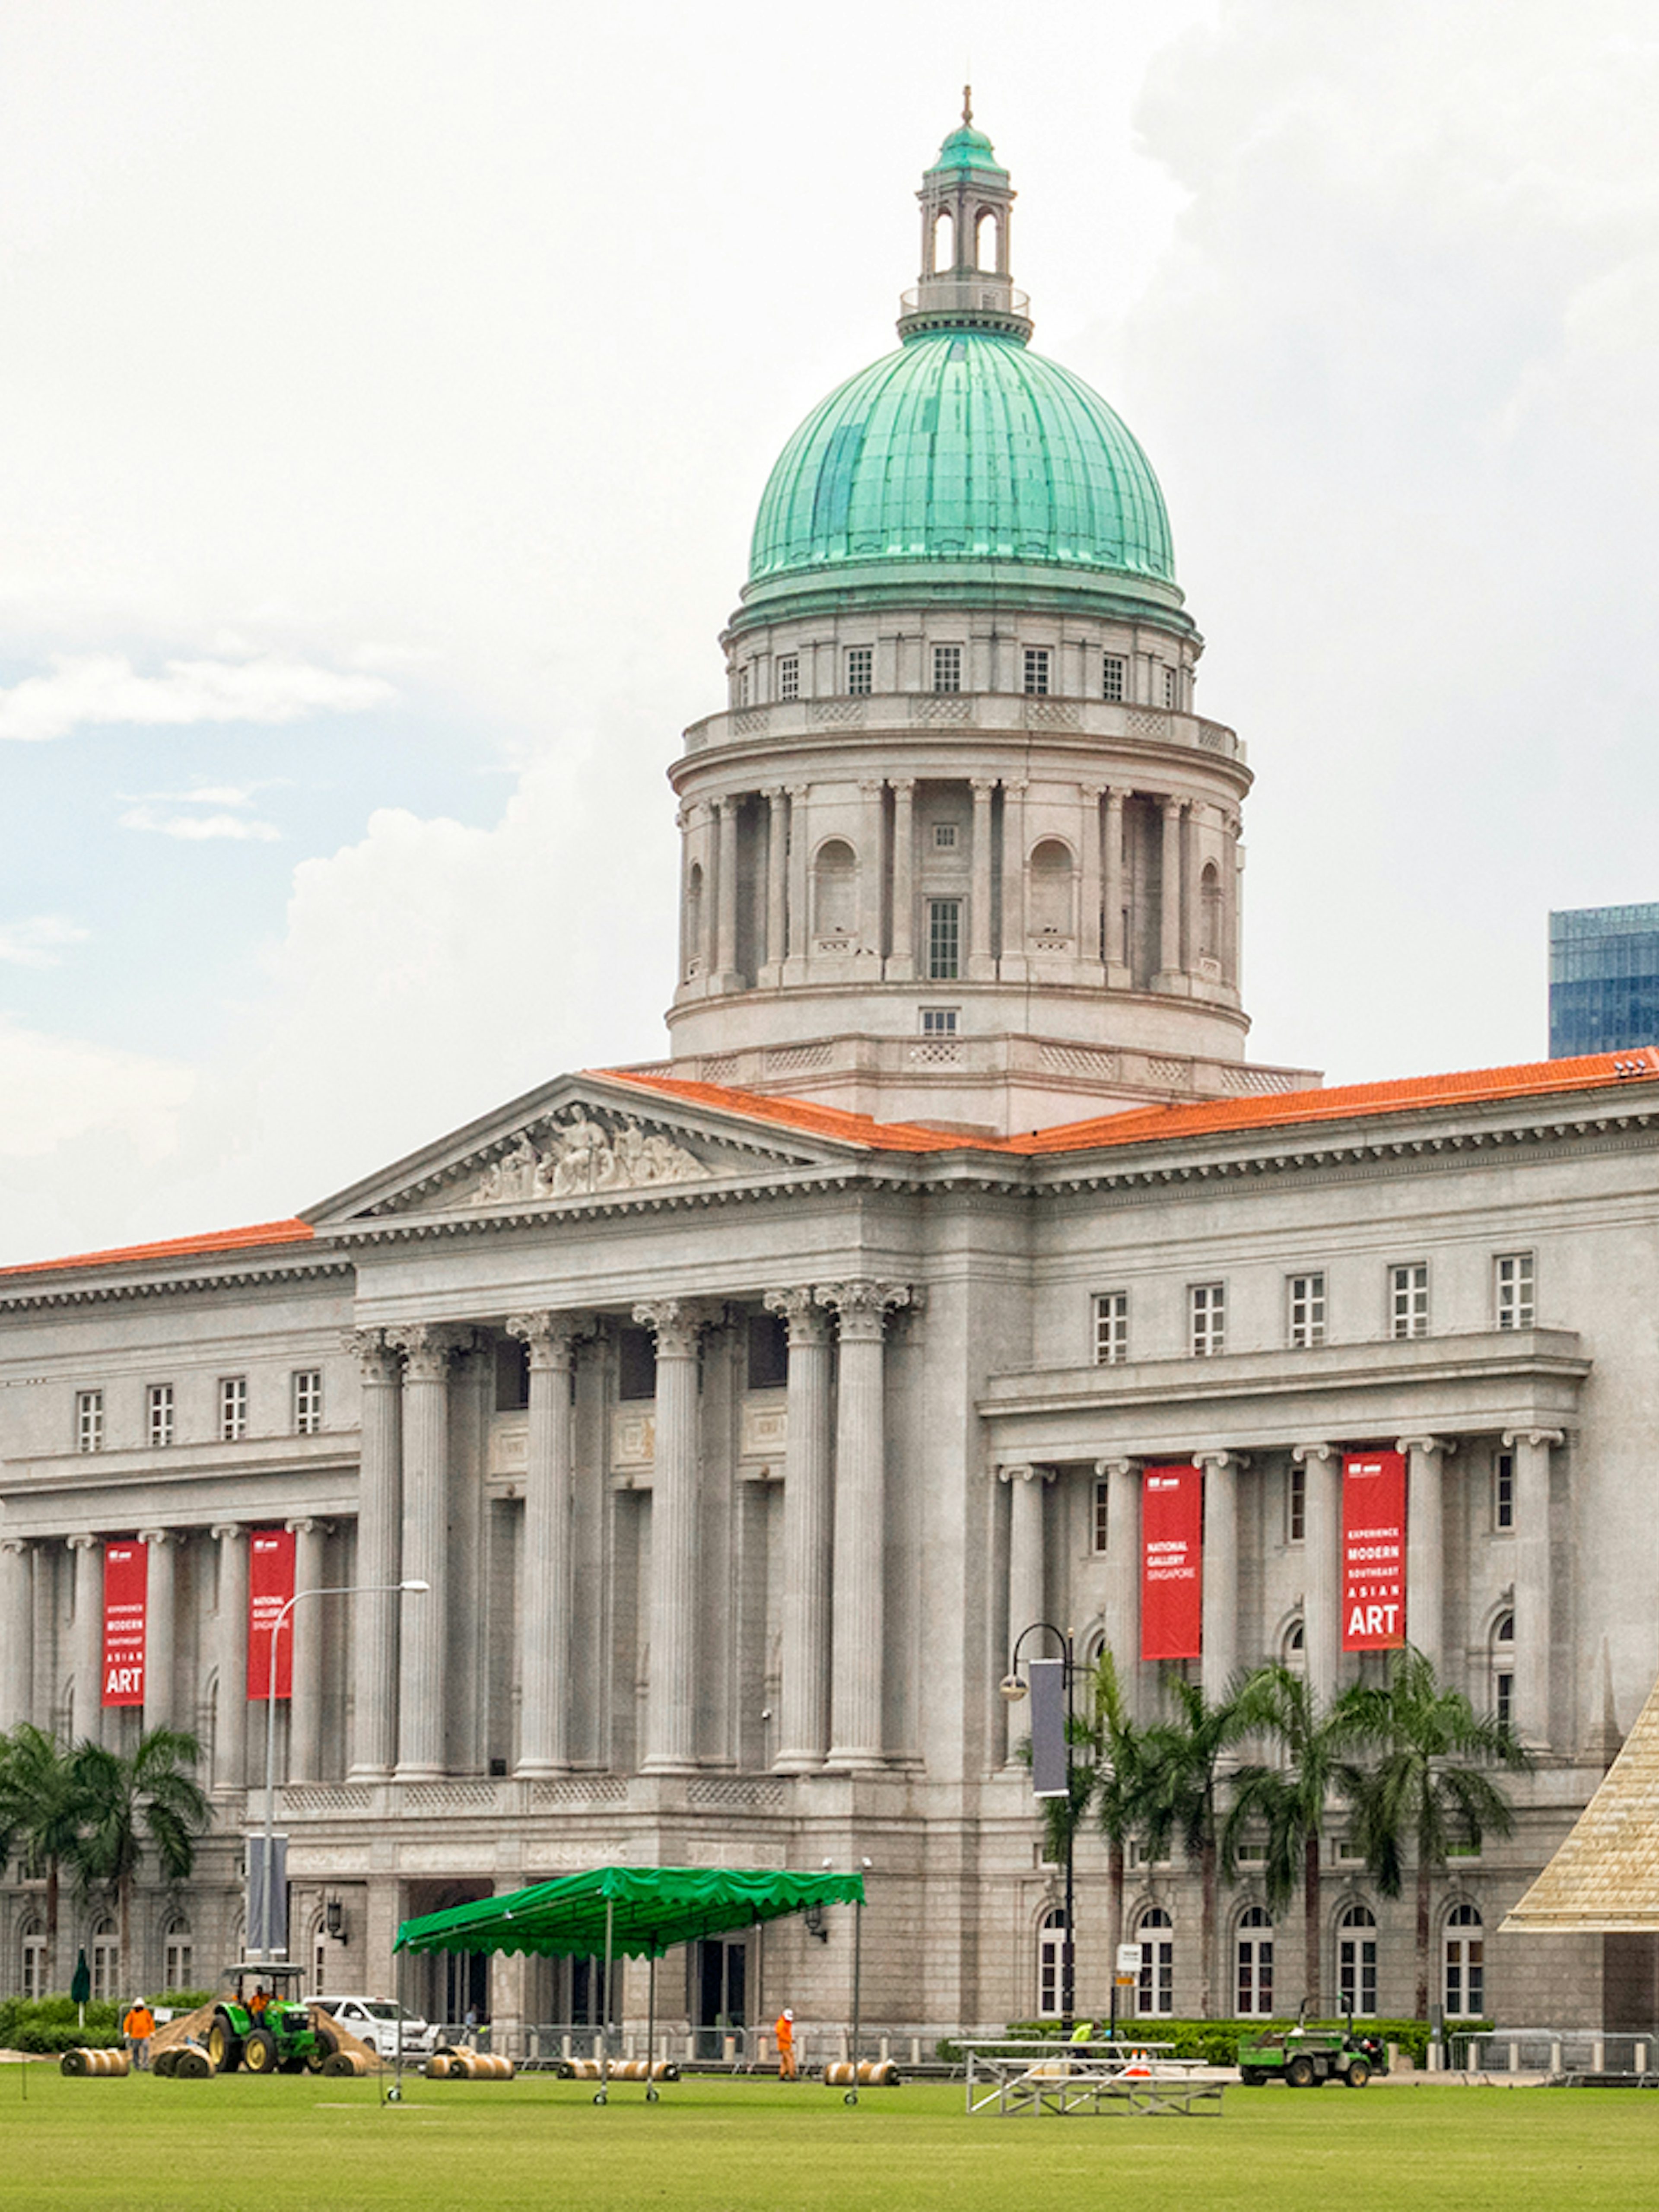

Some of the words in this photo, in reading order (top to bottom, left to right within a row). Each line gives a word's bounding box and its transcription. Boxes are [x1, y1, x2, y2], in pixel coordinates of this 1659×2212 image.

[1348, 1527, 1399, 1539] EXPERIENCE
[1147, 1541, 1188, 1553] NATIONAL
[1348, 1545, 1399, 1560] MODERN
[1147, 1555, 1185, 1567] GALLERY
[1147, 1567, 1195, 1580] SINGAPORE
[1348, 1566, 1399, 1579] SOUTHEAST
[1348, 1584, 1399, 1598] ASIAN
[253, 1607, 284, 1618] GALLER
[108, 1620, 143, 1631] MODERN
[1348, 1604, 1400, 1636] ART
[107, 1651, 143, 1663] ASIAN
[106, 1667, 143, 1694] ART
